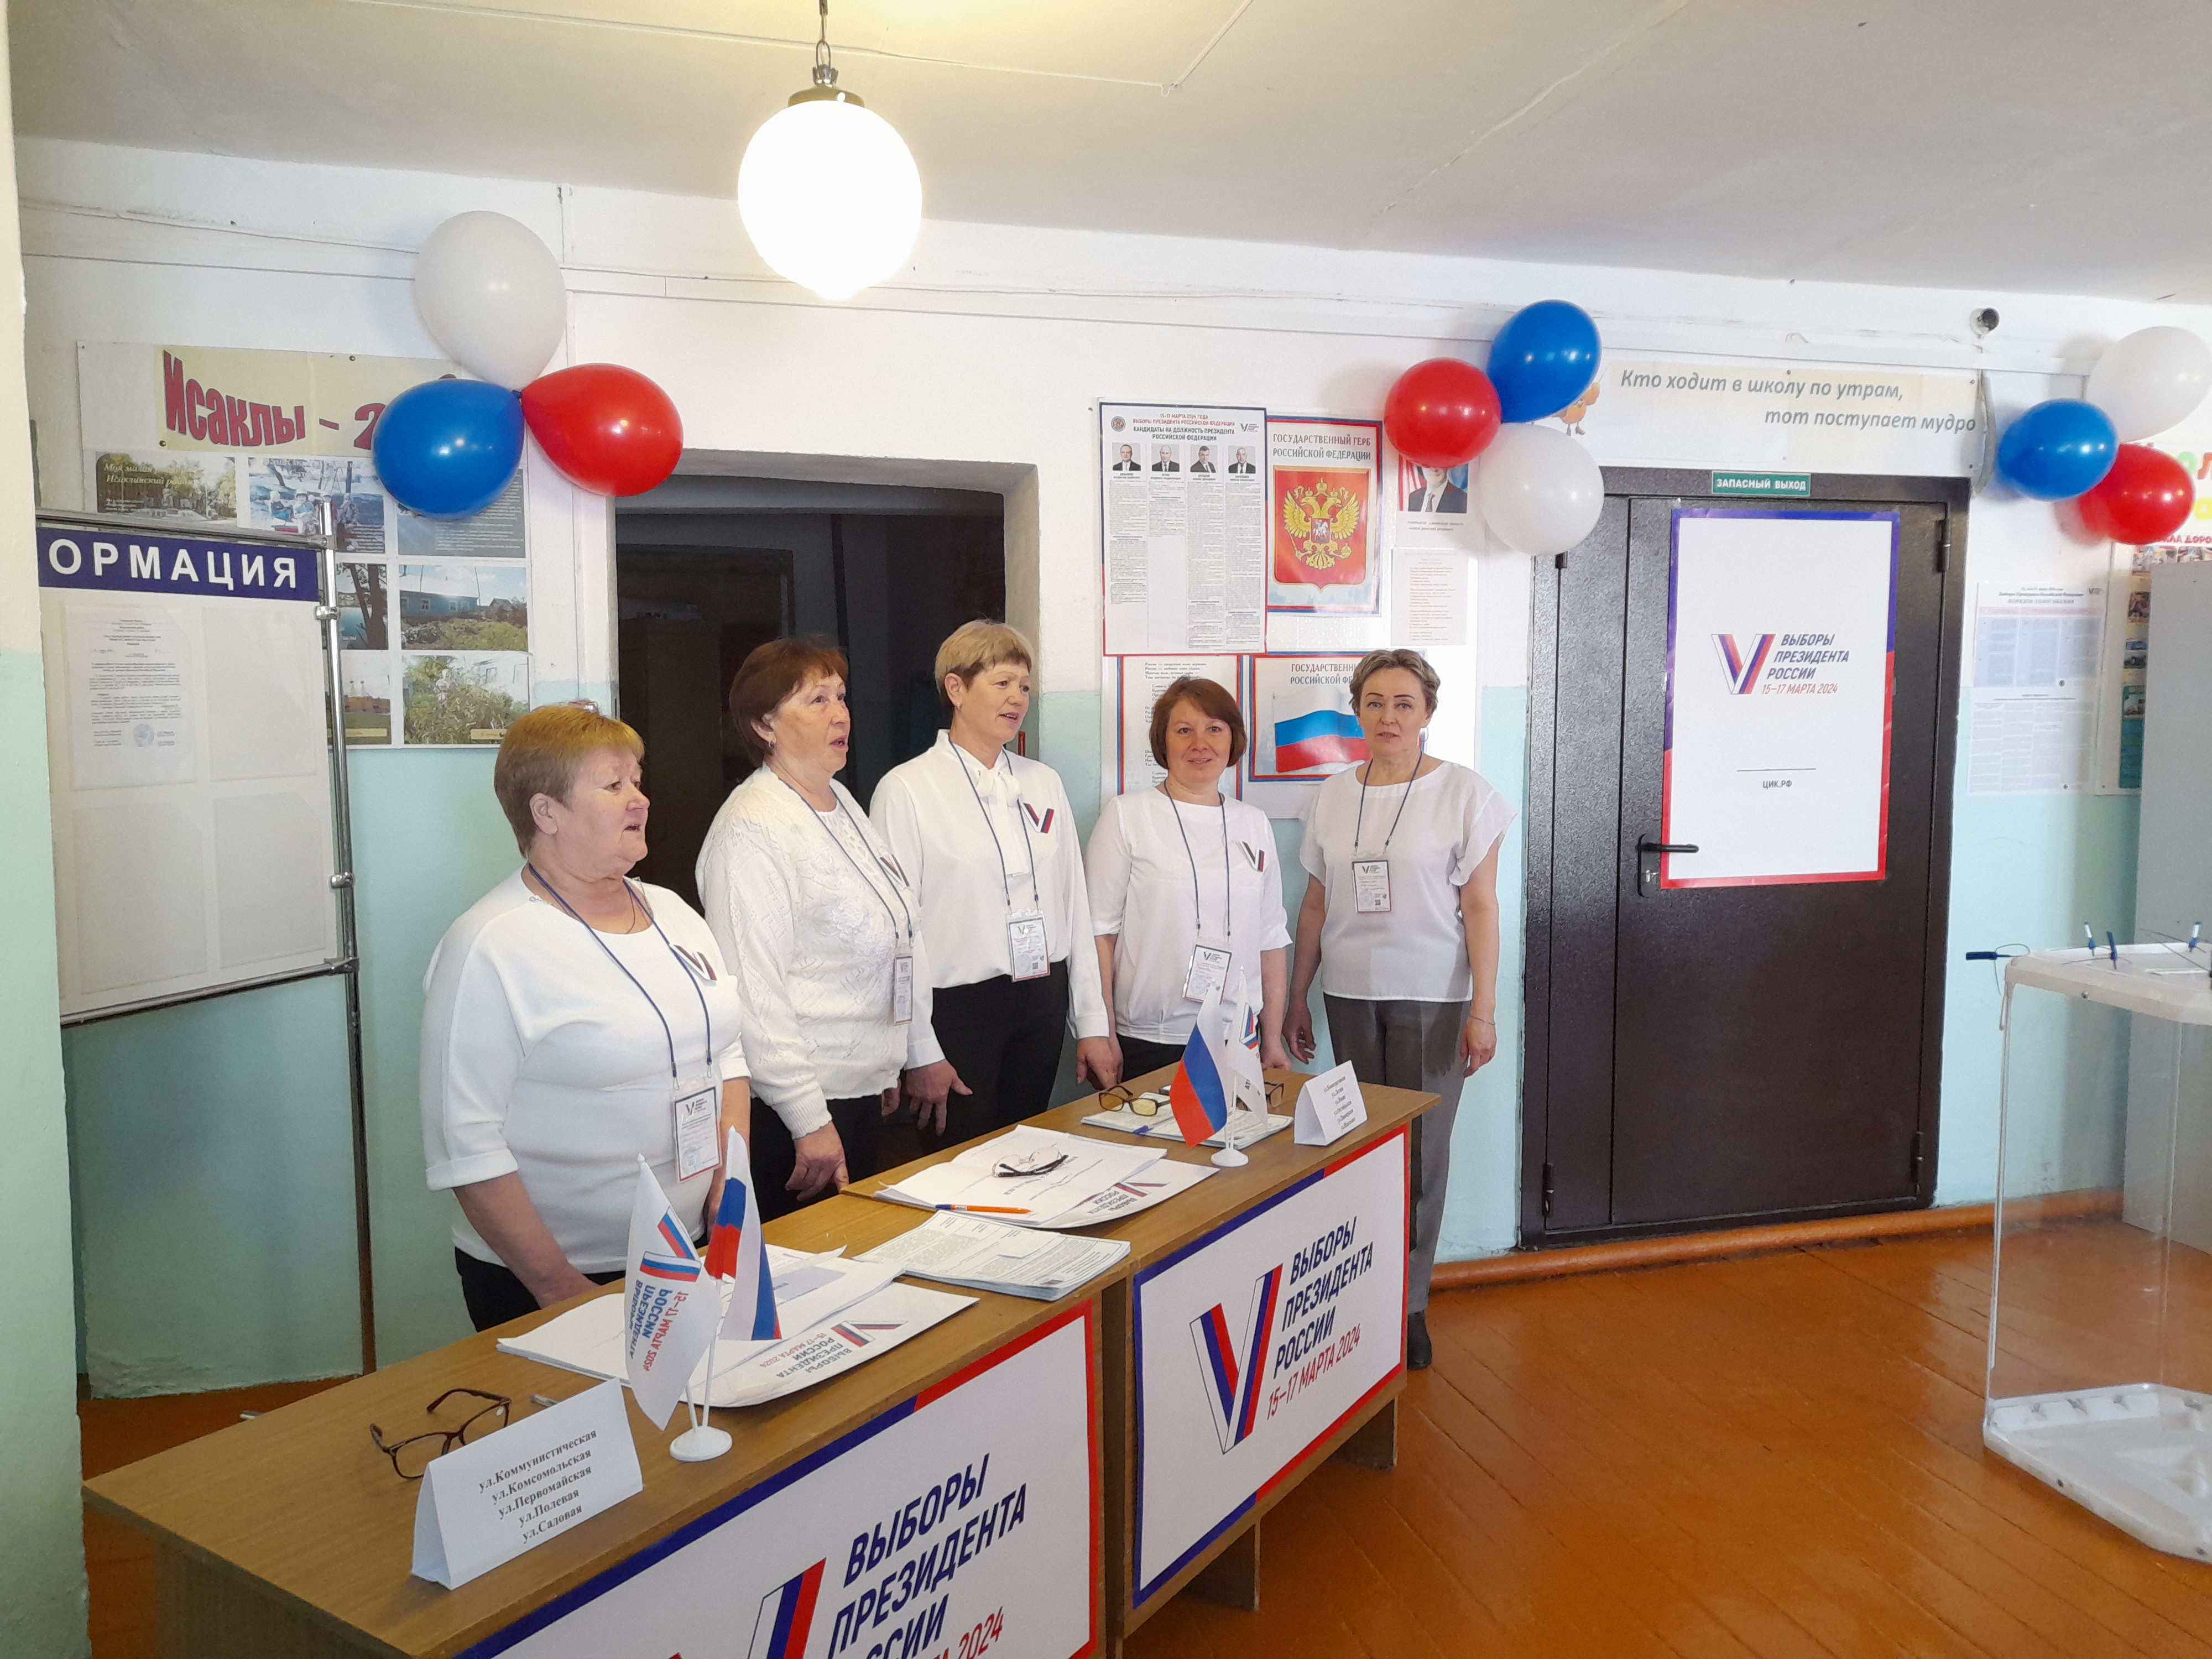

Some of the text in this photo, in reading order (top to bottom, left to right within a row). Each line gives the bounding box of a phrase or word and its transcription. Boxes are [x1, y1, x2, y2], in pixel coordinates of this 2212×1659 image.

[163, 350, 305, 447] Исаклы
[1621, 369, 1903, 401] Кто ходит в школу по утрам,
[1765, 410, 1976, 434] тот поступает мудро
[1273, 434, 1371, 446] ГОСУДАРСТВЕННЫЙ ГЕРБ
[1273, 446, 1371, 461] РОССИЙСКОЙ ФЕДЕРАЦИИ
[1717, 478, 1806, 492] ЗАПАСНЫЙ ВЫХОД
[49, 539, 298, 591] ОРМАЦИЯ
[1773, 650, 1850, 664] ПРЕЗИДЕНТА
[1781, 634, 1835, 646] ВЫБОРЫ
[1290, 674, 1340, 685] РОССИЙСКОЙ
[1291, 664, 1357, 673] ГОСУДАРСТВЕНН
[1767, 667, 1817, 680] РОССИИ
[1787, 684, 1815, 695] МАРТА
[1817, 683, 1838, 694] 2024
[1762, 780, 1792, 790] ЦИК.РФ
[1290, 1215, 1357, 1286] ВЫБОРЫ
[1282, 1241, 1374, 1332] ПРЕЗИДЕНТА
[1274, 1305, 1336, 1379] РОССИИ
[1298, 1344, 1334, 1395] МАРТА
[1336, 1322, 1361, 1366] 2024
[478, 1430, 597, 1494] ул.Коммунистическая
[492, 1449, 592, 1505] ул.Комсомольская
[498, 1466, 592, 1520] ул.Первомайская
[519, 1489, 580, 1528] ул.Полевая
[843, 1453, 990, 1588] ВЫБОРЫ
[827, 1483, 1027, 1659] ПРЕЗИДЕНТА
